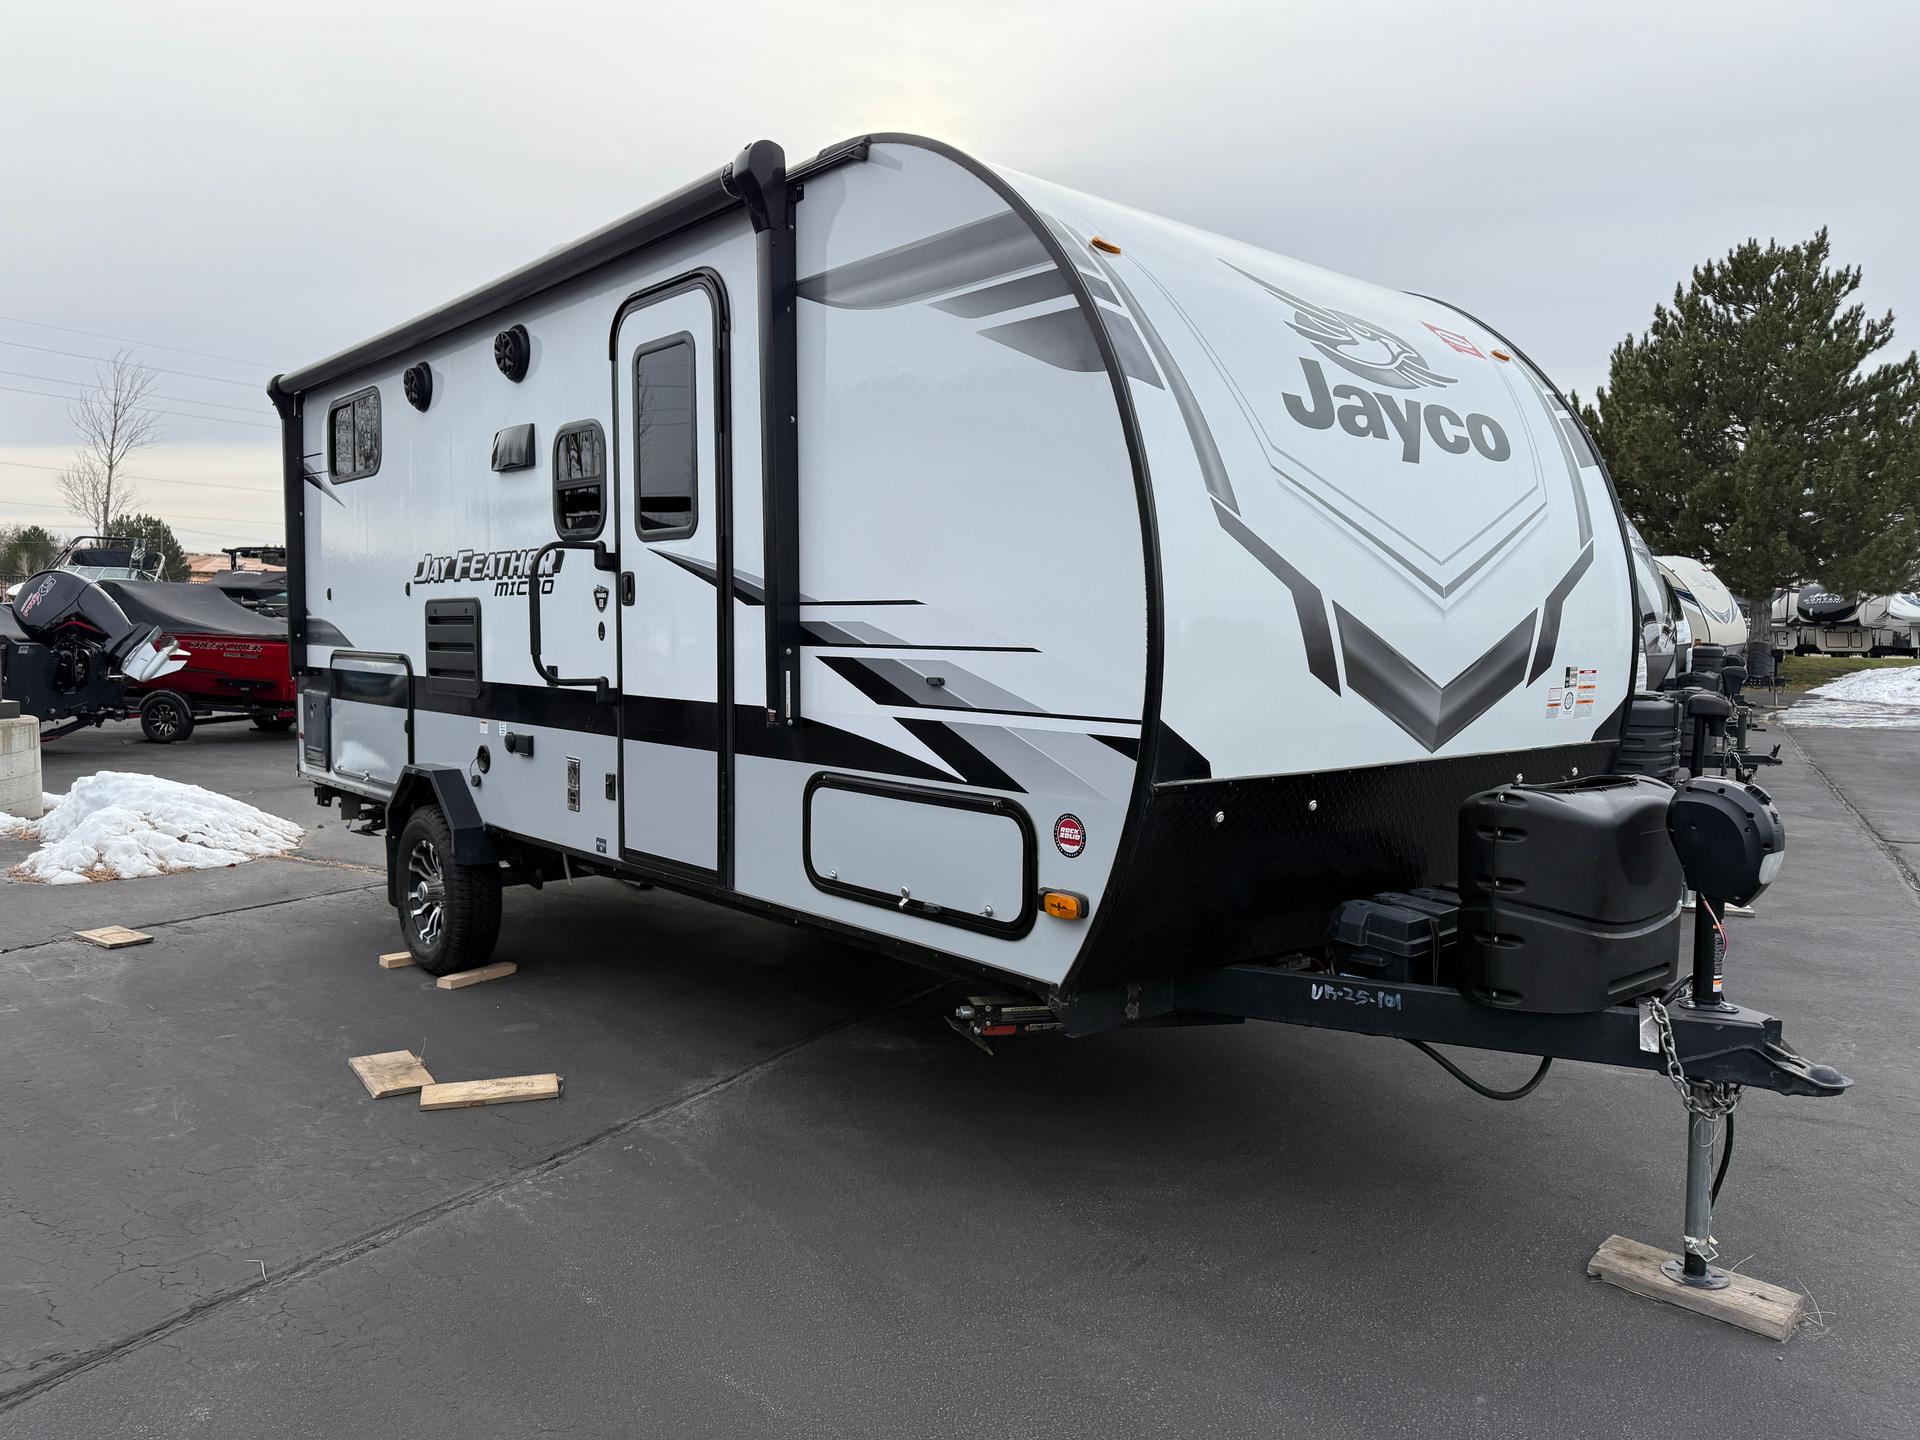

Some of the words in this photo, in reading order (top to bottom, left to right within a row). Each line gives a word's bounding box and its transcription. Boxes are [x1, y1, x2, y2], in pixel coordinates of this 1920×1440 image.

[1281, 356, 1511, 464] Jayco
[494, 579, 554, 597] MICO
[1059, 832, 1081, 841] SOLID
[1060, 826, 1080, 835] ROCK
